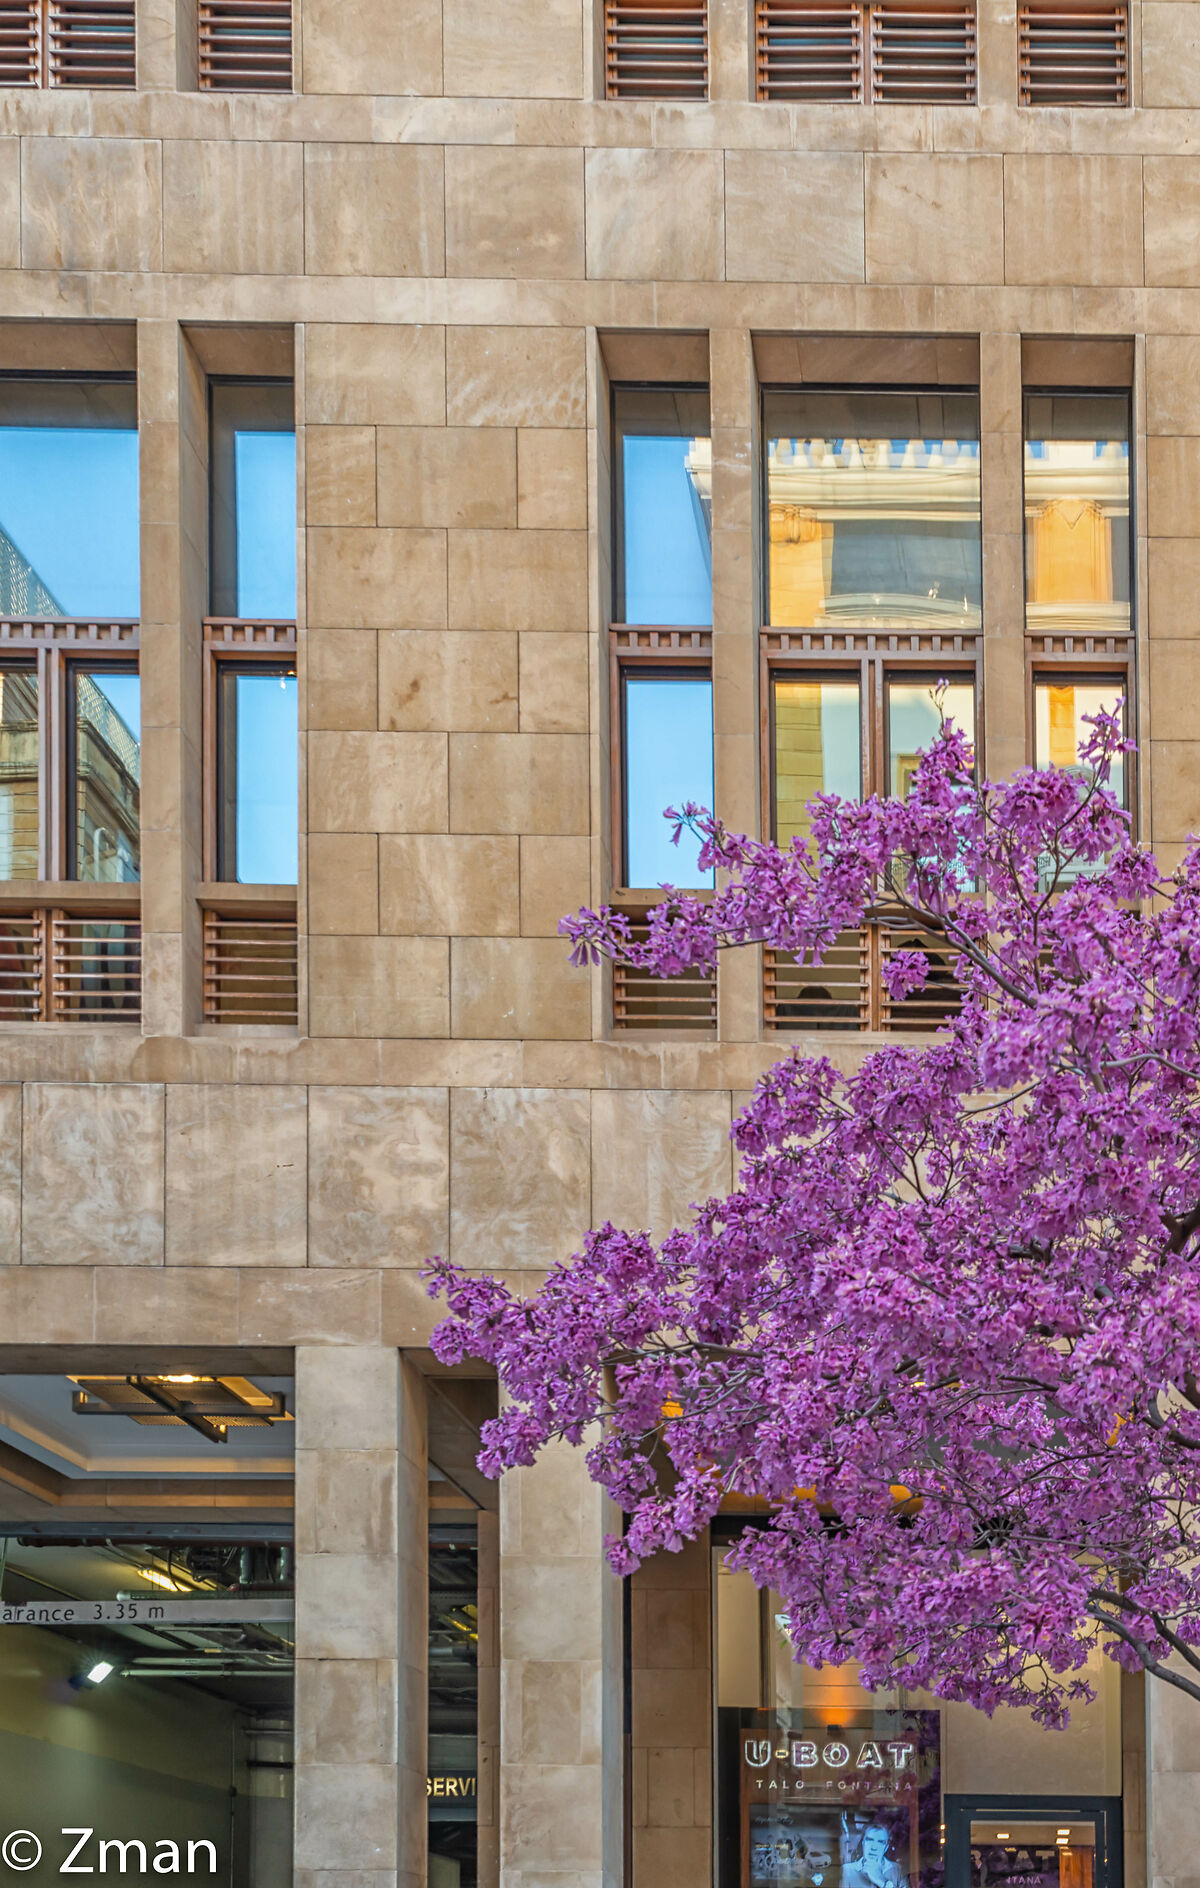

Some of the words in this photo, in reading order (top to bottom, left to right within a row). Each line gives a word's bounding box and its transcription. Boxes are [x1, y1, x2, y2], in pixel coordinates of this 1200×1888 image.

[2, 1608, 75, 1622] arance
[93, 1603, 138, 1620] 3.35
[148, 1606, 164, 1619] m
[744, 1740, 914, 1769] U-BOAT
[426, 1776, 476, 1797] SERVI
